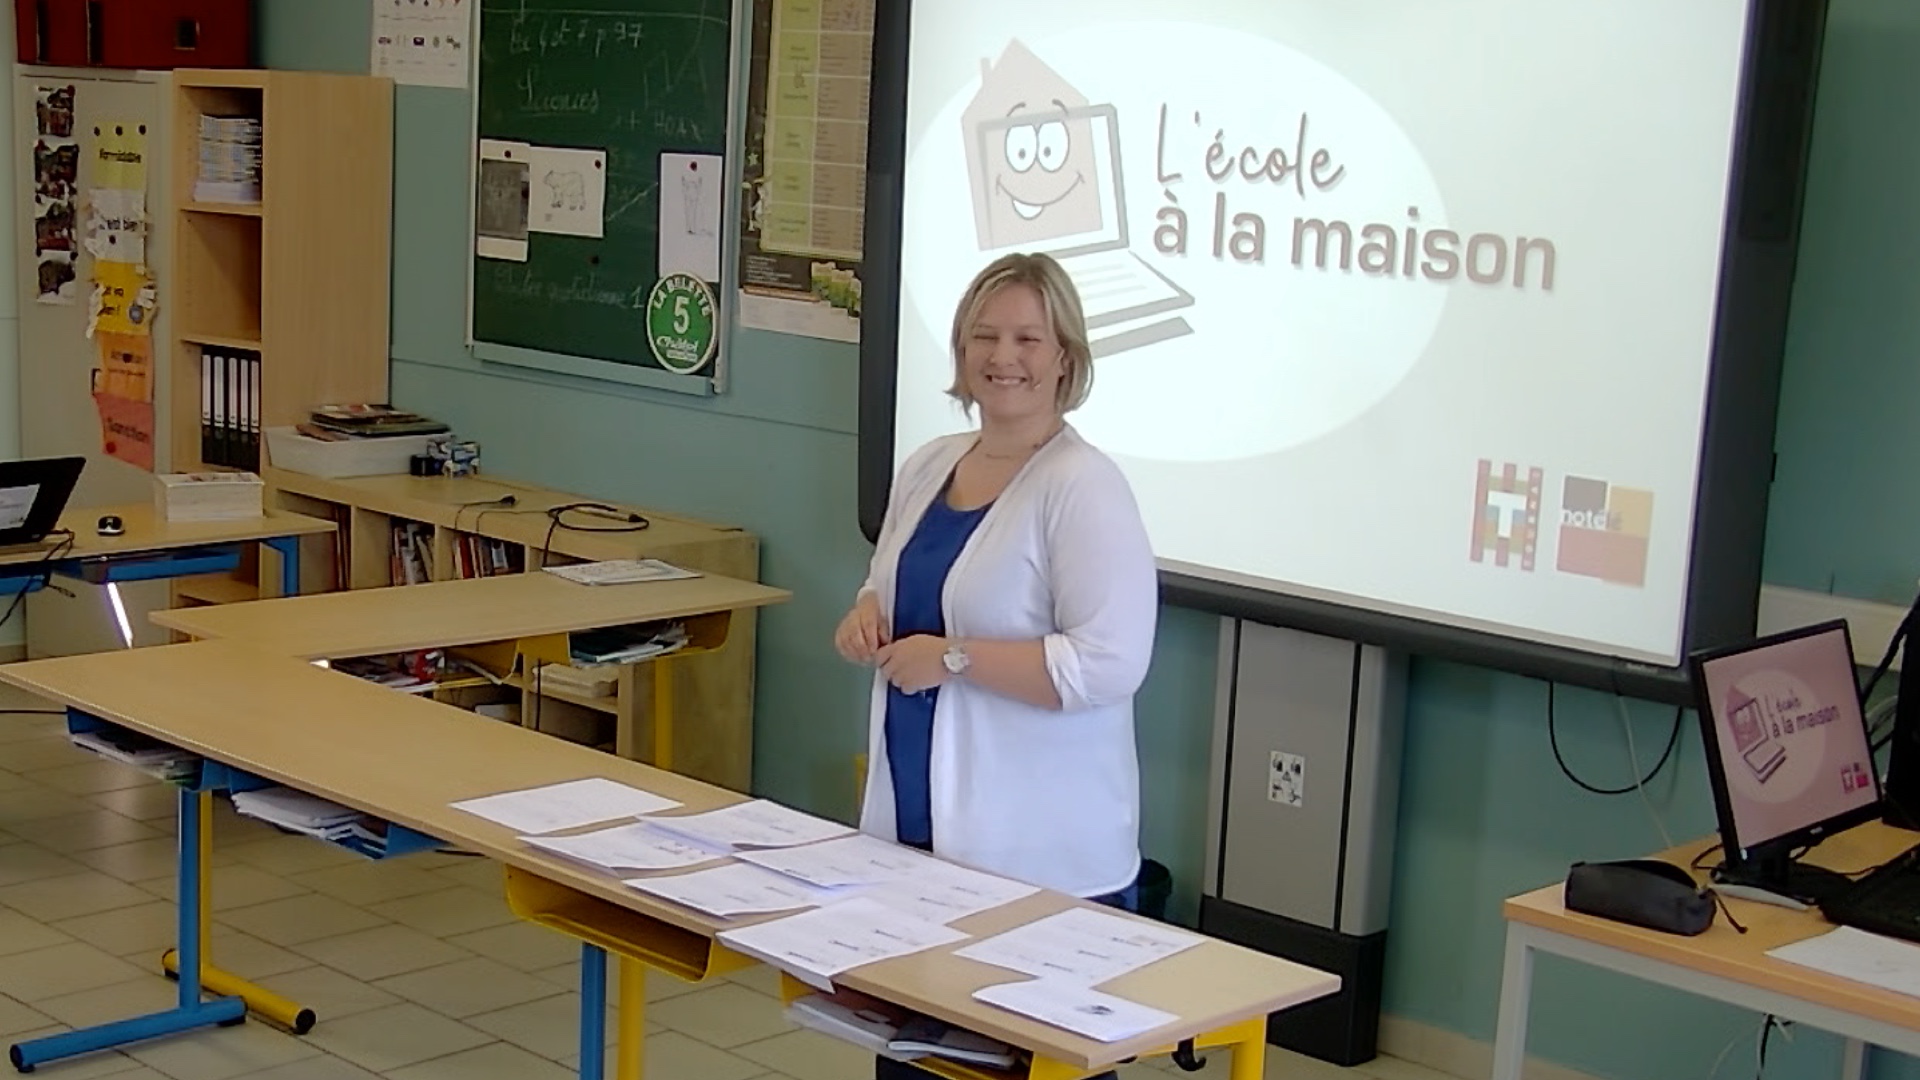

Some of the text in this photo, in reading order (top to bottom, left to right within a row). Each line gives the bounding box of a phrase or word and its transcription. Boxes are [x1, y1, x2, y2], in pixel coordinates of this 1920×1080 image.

[613, 20, 643, 49] 97
[1156, 102, 1345, 198] L'école
[1153, 187, 1557, 291] à la maison
[673, 295, 690, 334] 5
